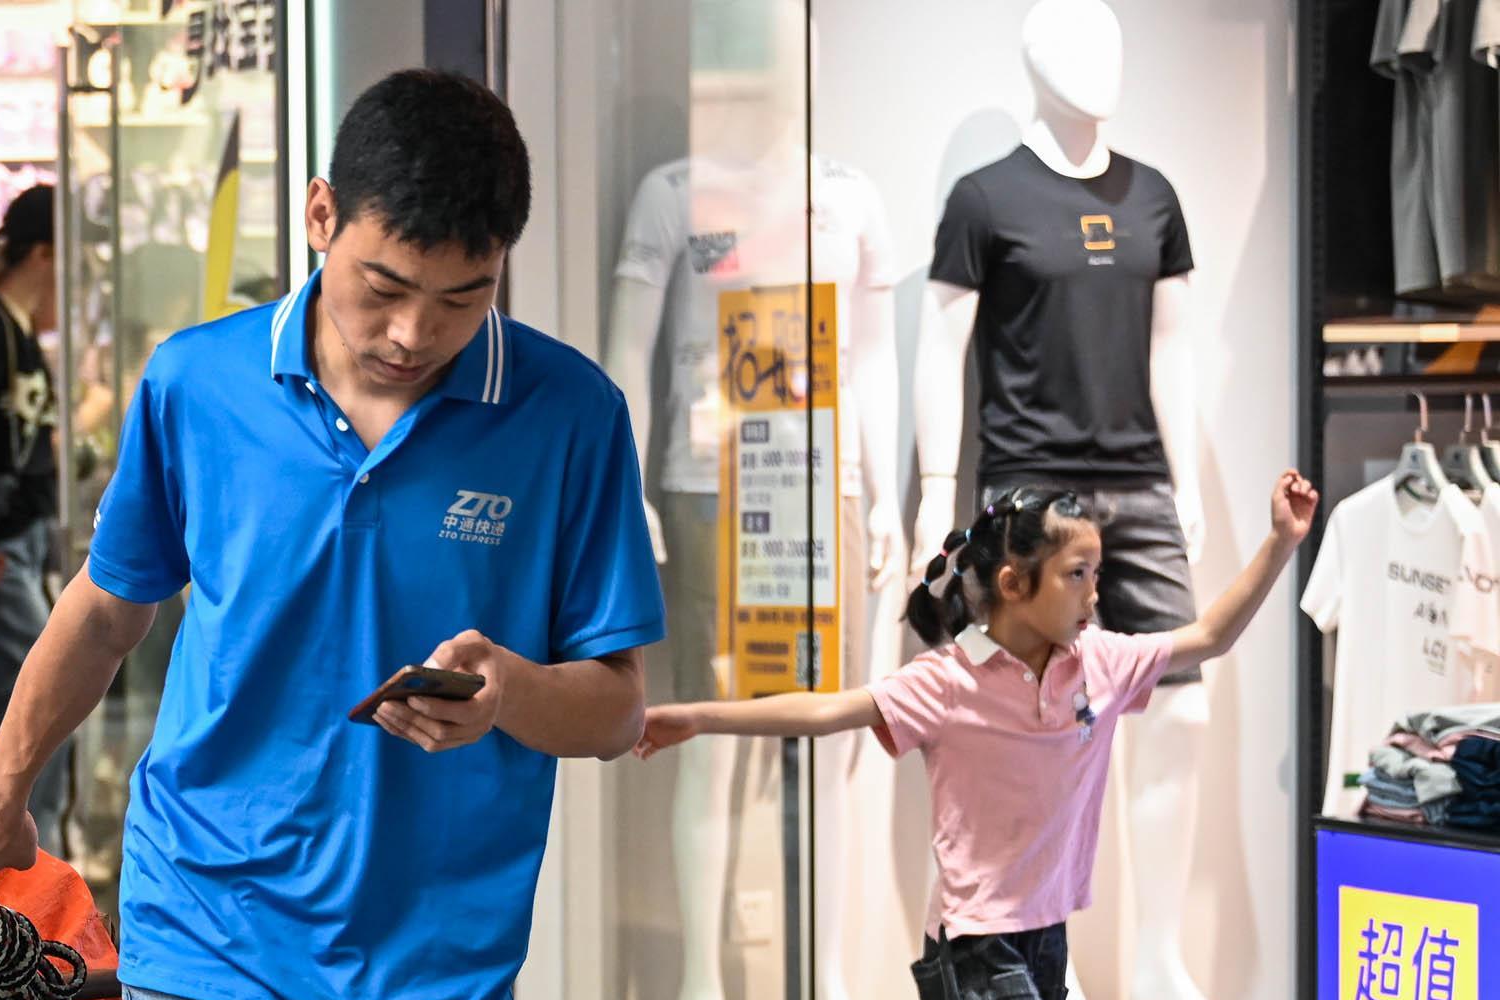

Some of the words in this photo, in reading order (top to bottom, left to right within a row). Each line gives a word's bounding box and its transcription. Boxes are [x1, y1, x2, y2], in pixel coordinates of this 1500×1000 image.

[446, 489, 512, 520] ZTO
[443, 514, 505, 537] 中通快递
